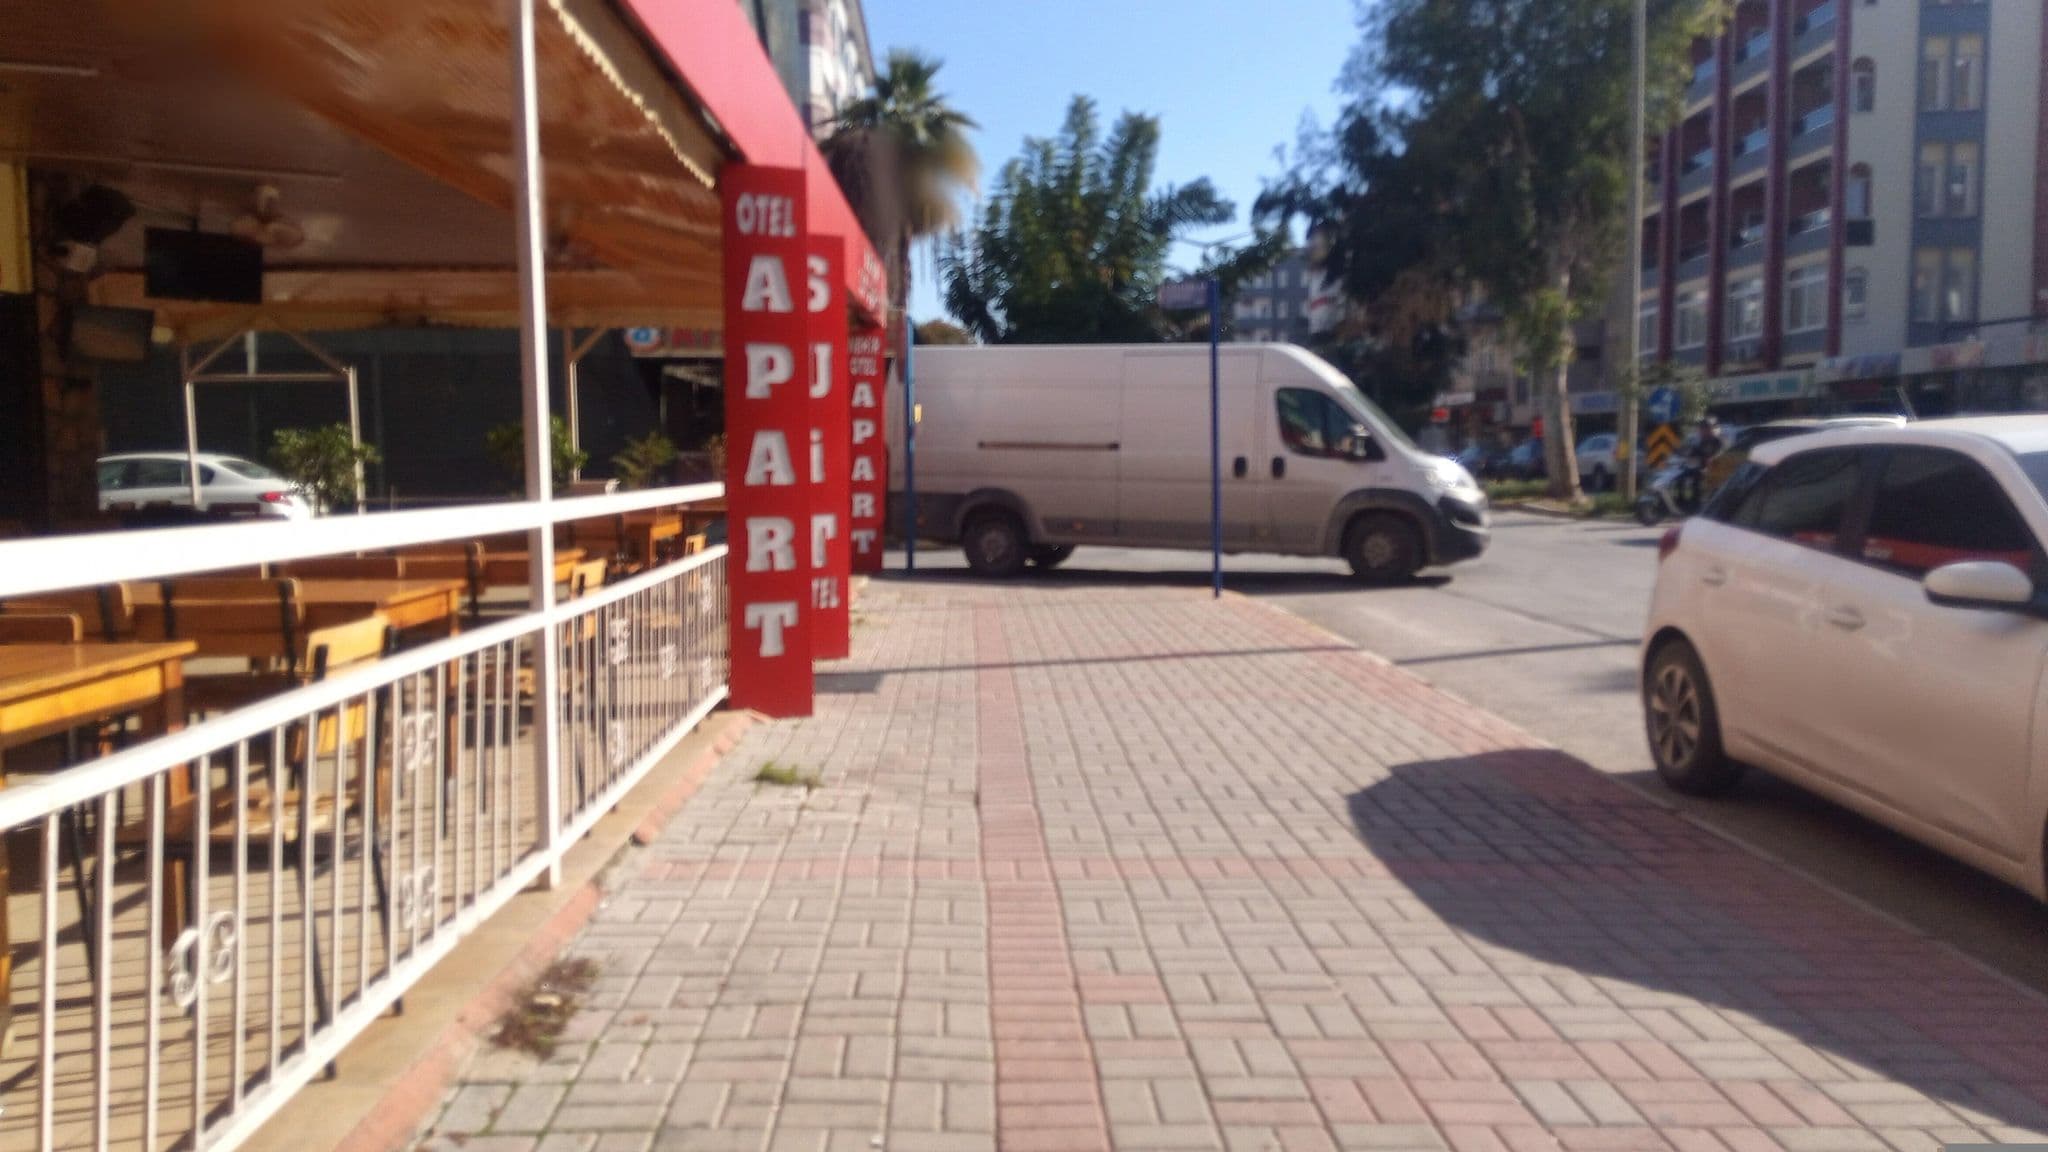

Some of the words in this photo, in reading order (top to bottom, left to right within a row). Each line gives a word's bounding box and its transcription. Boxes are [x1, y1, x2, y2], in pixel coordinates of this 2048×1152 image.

[737, 194, 794, 236] OTEL
[743, 256, 798, 656] APART
[851, 381, 877, 553] APART
[811, 577, 838, 608] TEL
